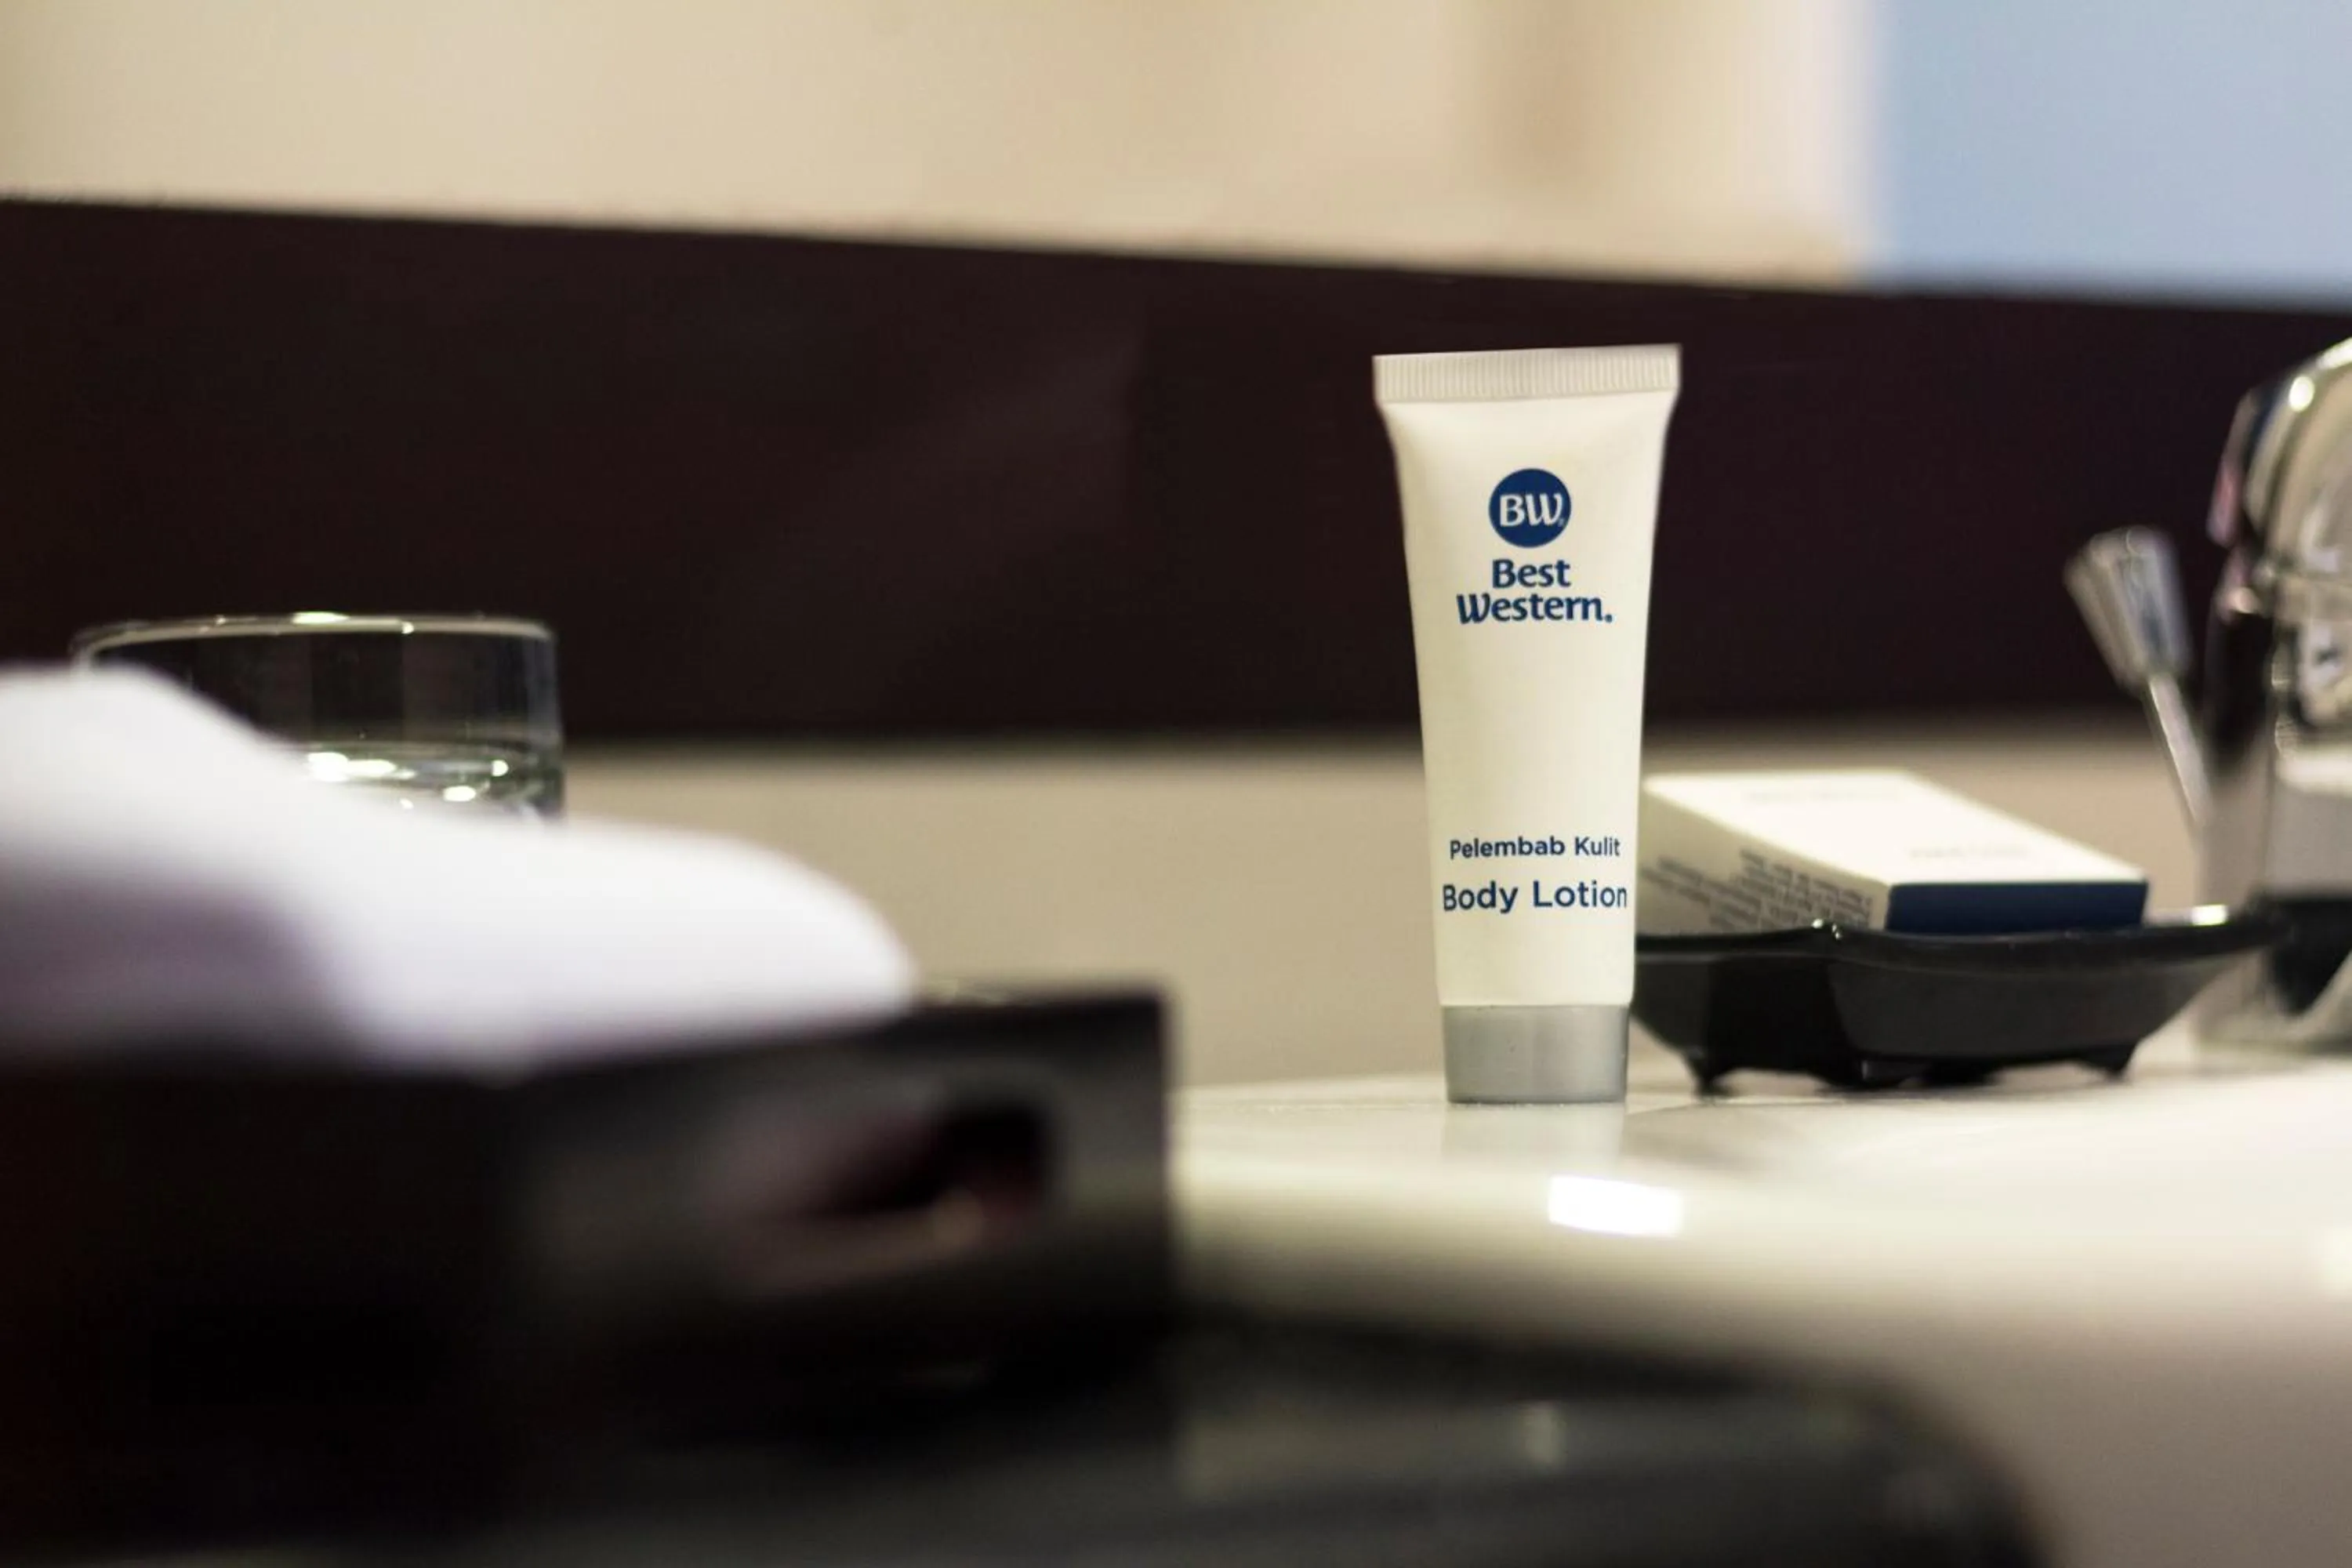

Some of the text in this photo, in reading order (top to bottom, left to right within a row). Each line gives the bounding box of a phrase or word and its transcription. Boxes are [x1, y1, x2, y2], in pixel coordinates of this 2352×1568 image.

[1500, 493, 1563, 527] BW
[1492, 559, 1570, 588] Best
[1450, 836, 1621, 859] Pelembab Kulit
[1443, 880, 1519, 913] Body
[1533, 880, 1628, 908] Lotion
